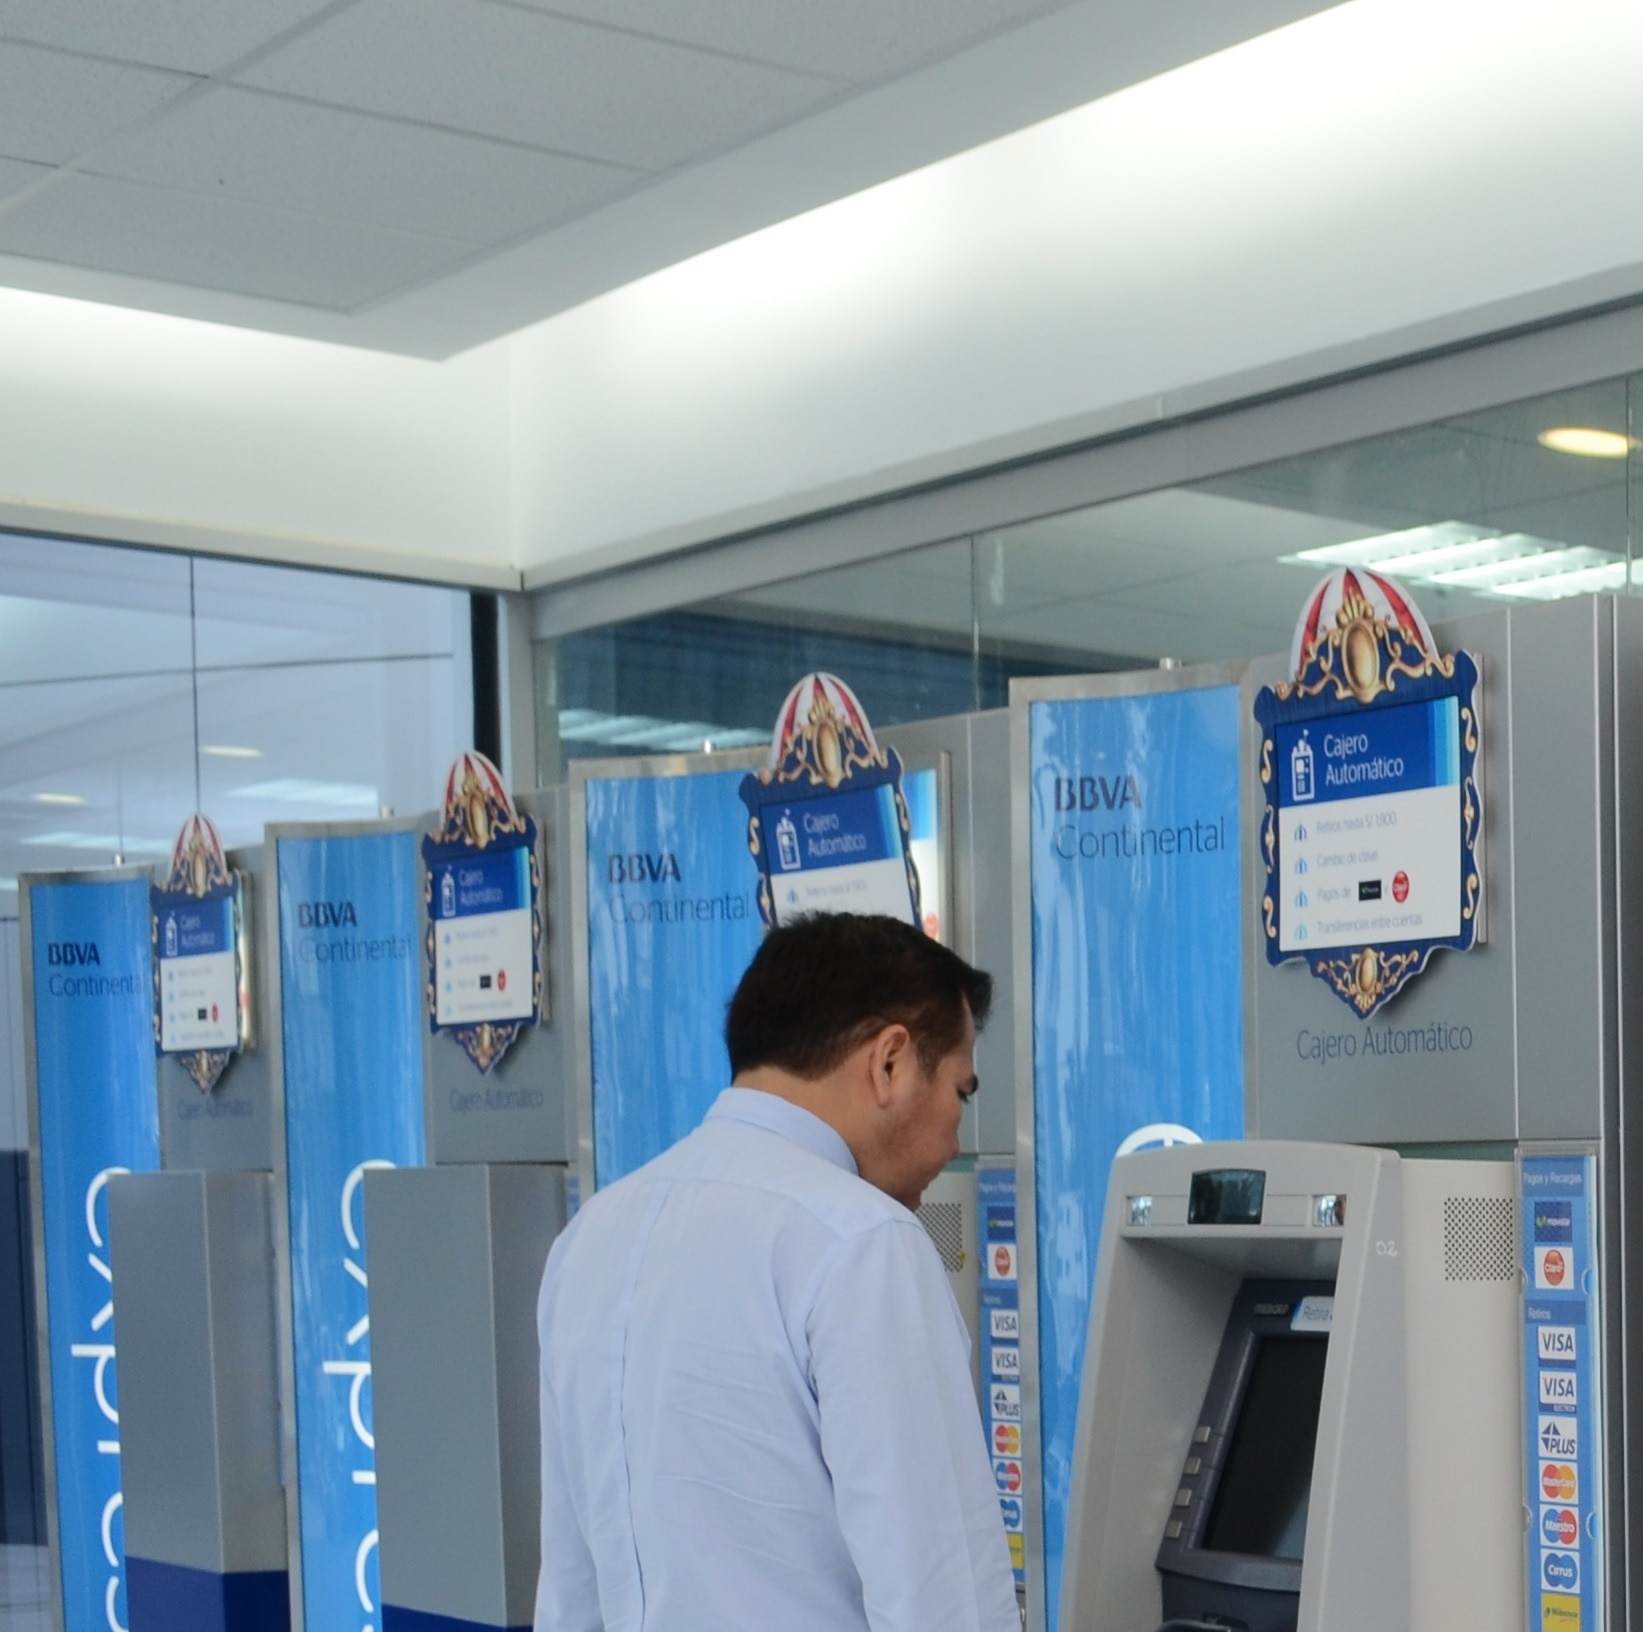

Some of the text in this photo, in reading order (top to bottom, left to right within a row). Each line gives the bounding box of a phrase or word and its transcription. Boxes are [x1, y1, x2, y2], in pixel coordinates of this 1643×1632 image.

[1323, 734, 1368, 759] Cajero
[1325, 756, 1404, 786] Automático
[1054, 775, 1142, 812] BBVA
[803, 812, 839, 832] Cajero
[1055, 816, 1225, 859] Continental
[609, 853, 681, 883] BBVA
[298, 902, 358, 929] BBVA
[609, 893, 750, 924] Continental
[48, 942, 101, 967] BBVA
[1297, 1022, 1473, 1065] Cajero Automático
[994, 1315, 1017, 1331] VISA
[1542, 1333, 1573, 1352] VISA
[995, 1354, 1018, 1369] VISA
[1543, 1377, 1575, 1397] VISA
[1549, 1439, 1576, 1454] PLUS
[1547, 1564, 1573, 1578] Cirrus
